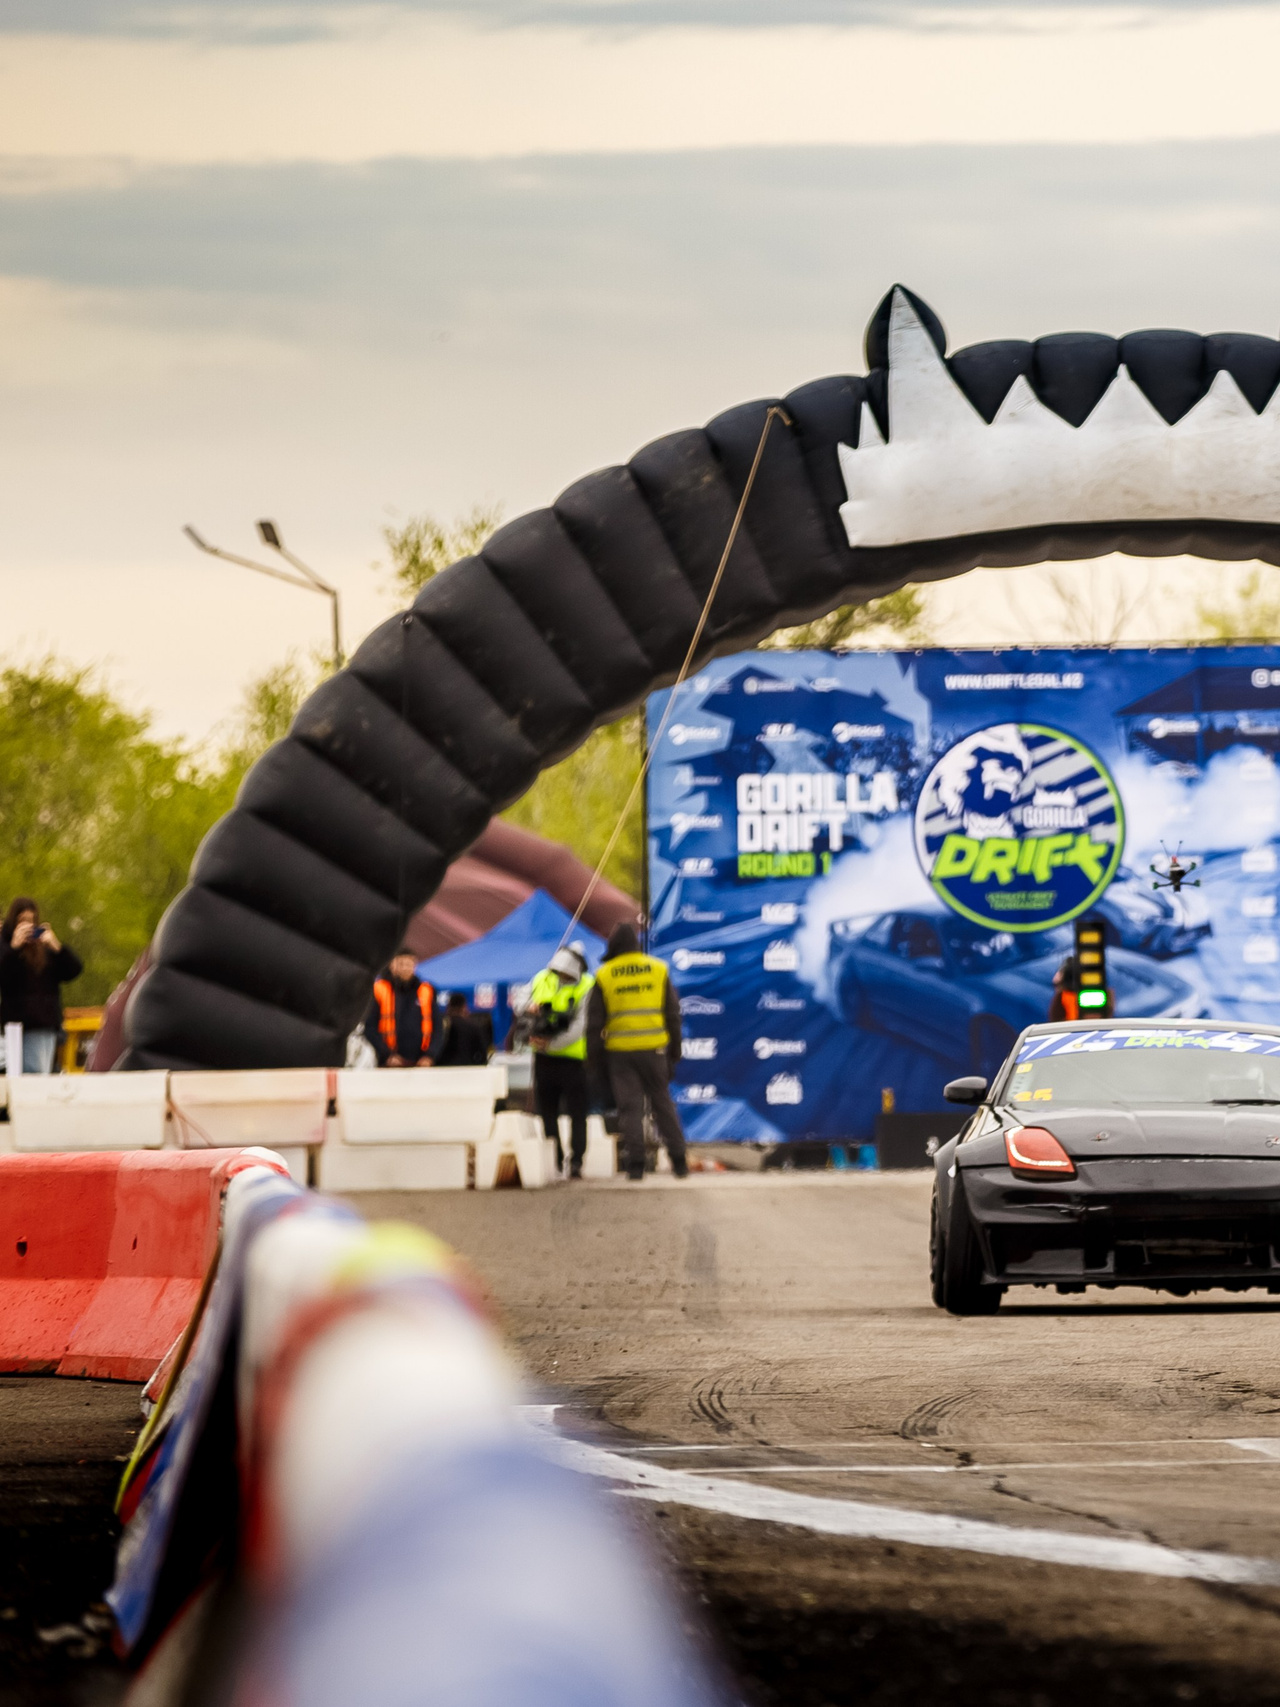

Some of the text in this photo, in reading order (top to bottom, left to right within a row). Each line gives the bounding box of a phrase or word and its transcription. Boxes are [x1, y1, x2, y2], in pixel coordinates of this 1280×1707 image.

[736, 772, 899, 813] GORILLA
[737, 812, 847, 852] DRIFT
[1022, 804, 1088, 829] GORILLA
[737, 852, 816, 877] ROUND
[819, 851, 832, 875] 1
[932, 832, 1109, 886] DRIFT
